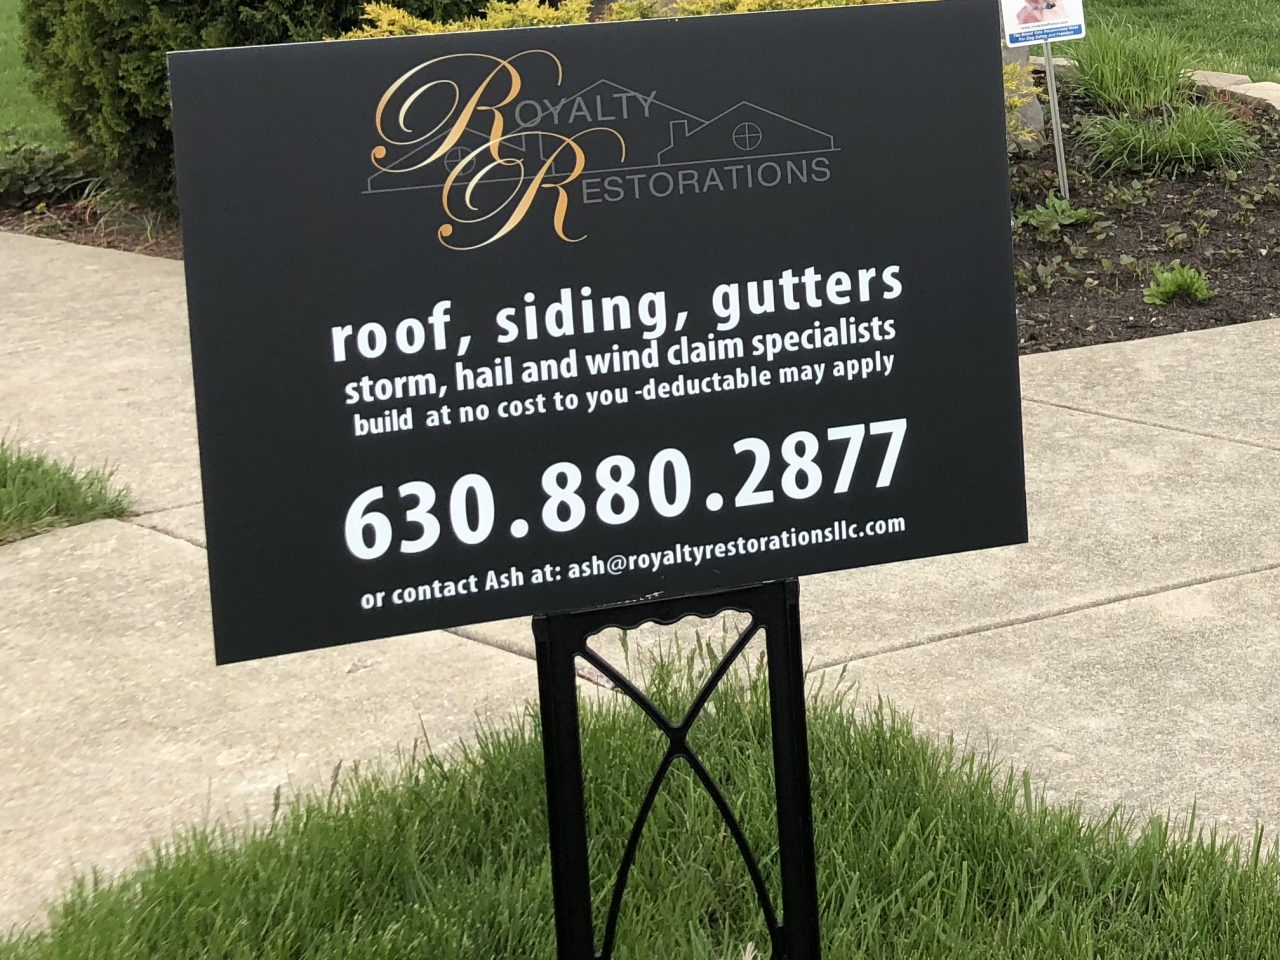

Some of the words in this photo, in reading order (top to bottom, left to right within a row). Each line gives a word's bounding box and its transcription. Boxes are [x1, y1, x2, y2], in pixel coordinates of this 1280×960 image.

[371, 49, 657, 173] ROYALTY
[438, 127, 832, 251] RESTORATIONS
[331, 300, 472, 363] roof,
[495, 286, 689, 344] siding,
[712, 265, 903, 331] gutters
[345, 372, 448, 405] storm,
[455, 356, 514, 391] hail
[521, 348, 578, 383] and
[585, 339, 660, 376] wind
[667, 332, 744, 366] claim
[751, 316, 897, 361] specialists
[353, 407, 414, 437] build
[425, 405, 452, 428] at
[459, 403, 490, 423] no
[497, 393, 547, 418] cost
[553, 390, 579, 412] to
[587, 387, 629, 413] you
[634, 365, 772, 401] -deductable
[779, 362, 826, 385] may
[832, 350, 895, 381] apply
[343, 418, 908, 561] 630.880.2877
[360, 590, 385, 611] or
[391, 574, 480, 605] contact
[484, 563, 524, 592] Ash
[531, 561, 562, 584] at:
[567, 514, 906, 580] ash@royaltyrestorationsllc.com
